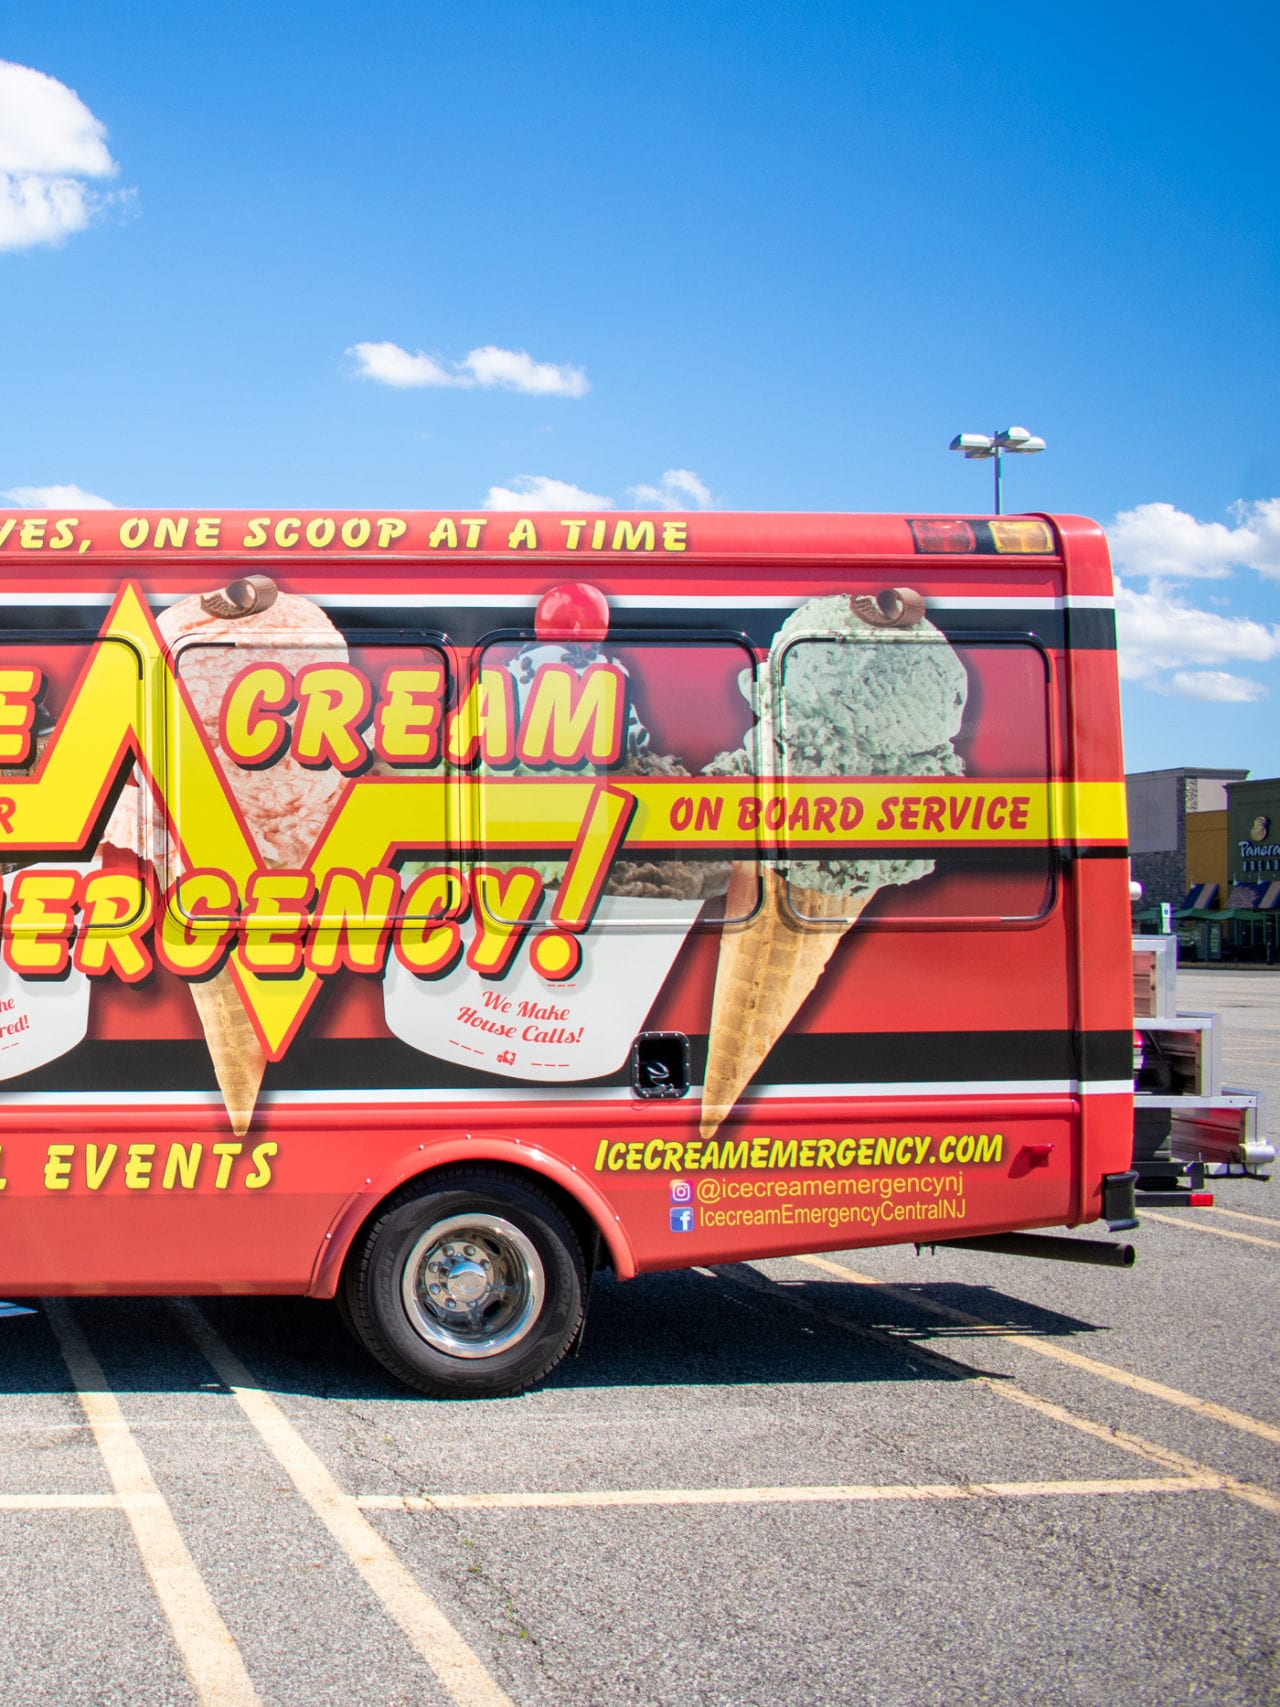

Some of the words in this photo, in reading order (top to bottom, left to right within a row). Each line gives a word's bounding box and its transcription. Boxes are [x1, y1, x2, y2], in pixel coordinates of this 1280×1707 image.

[119, 517, 222, 549] ONE
[242, 517, 408, 549] SCOOP
[428, 517, 488, 549] AT
[508, 518, 538, 550] A
[560, 519, 688, 552] TIME
[222, 662, 627, 771] CREAM
[669, 797, 724, 832] ON
[737, 796, 865, 834] BOARD
[876, 796, 1031, 834] SERVICE
[481, 990, 512, 1014] We
[516, 1001, 570, 1021] Make
[456, 1006, 517, 1038] House
[521, 1025, 585, 1044] Calls!
[43, 1142, 279, 1191] EVENTS
[696, 1171, 964, 1204] @icecreamemergencynj
[699, 1198, 966, 1227] IcecreamEmergencyCentralNJ
